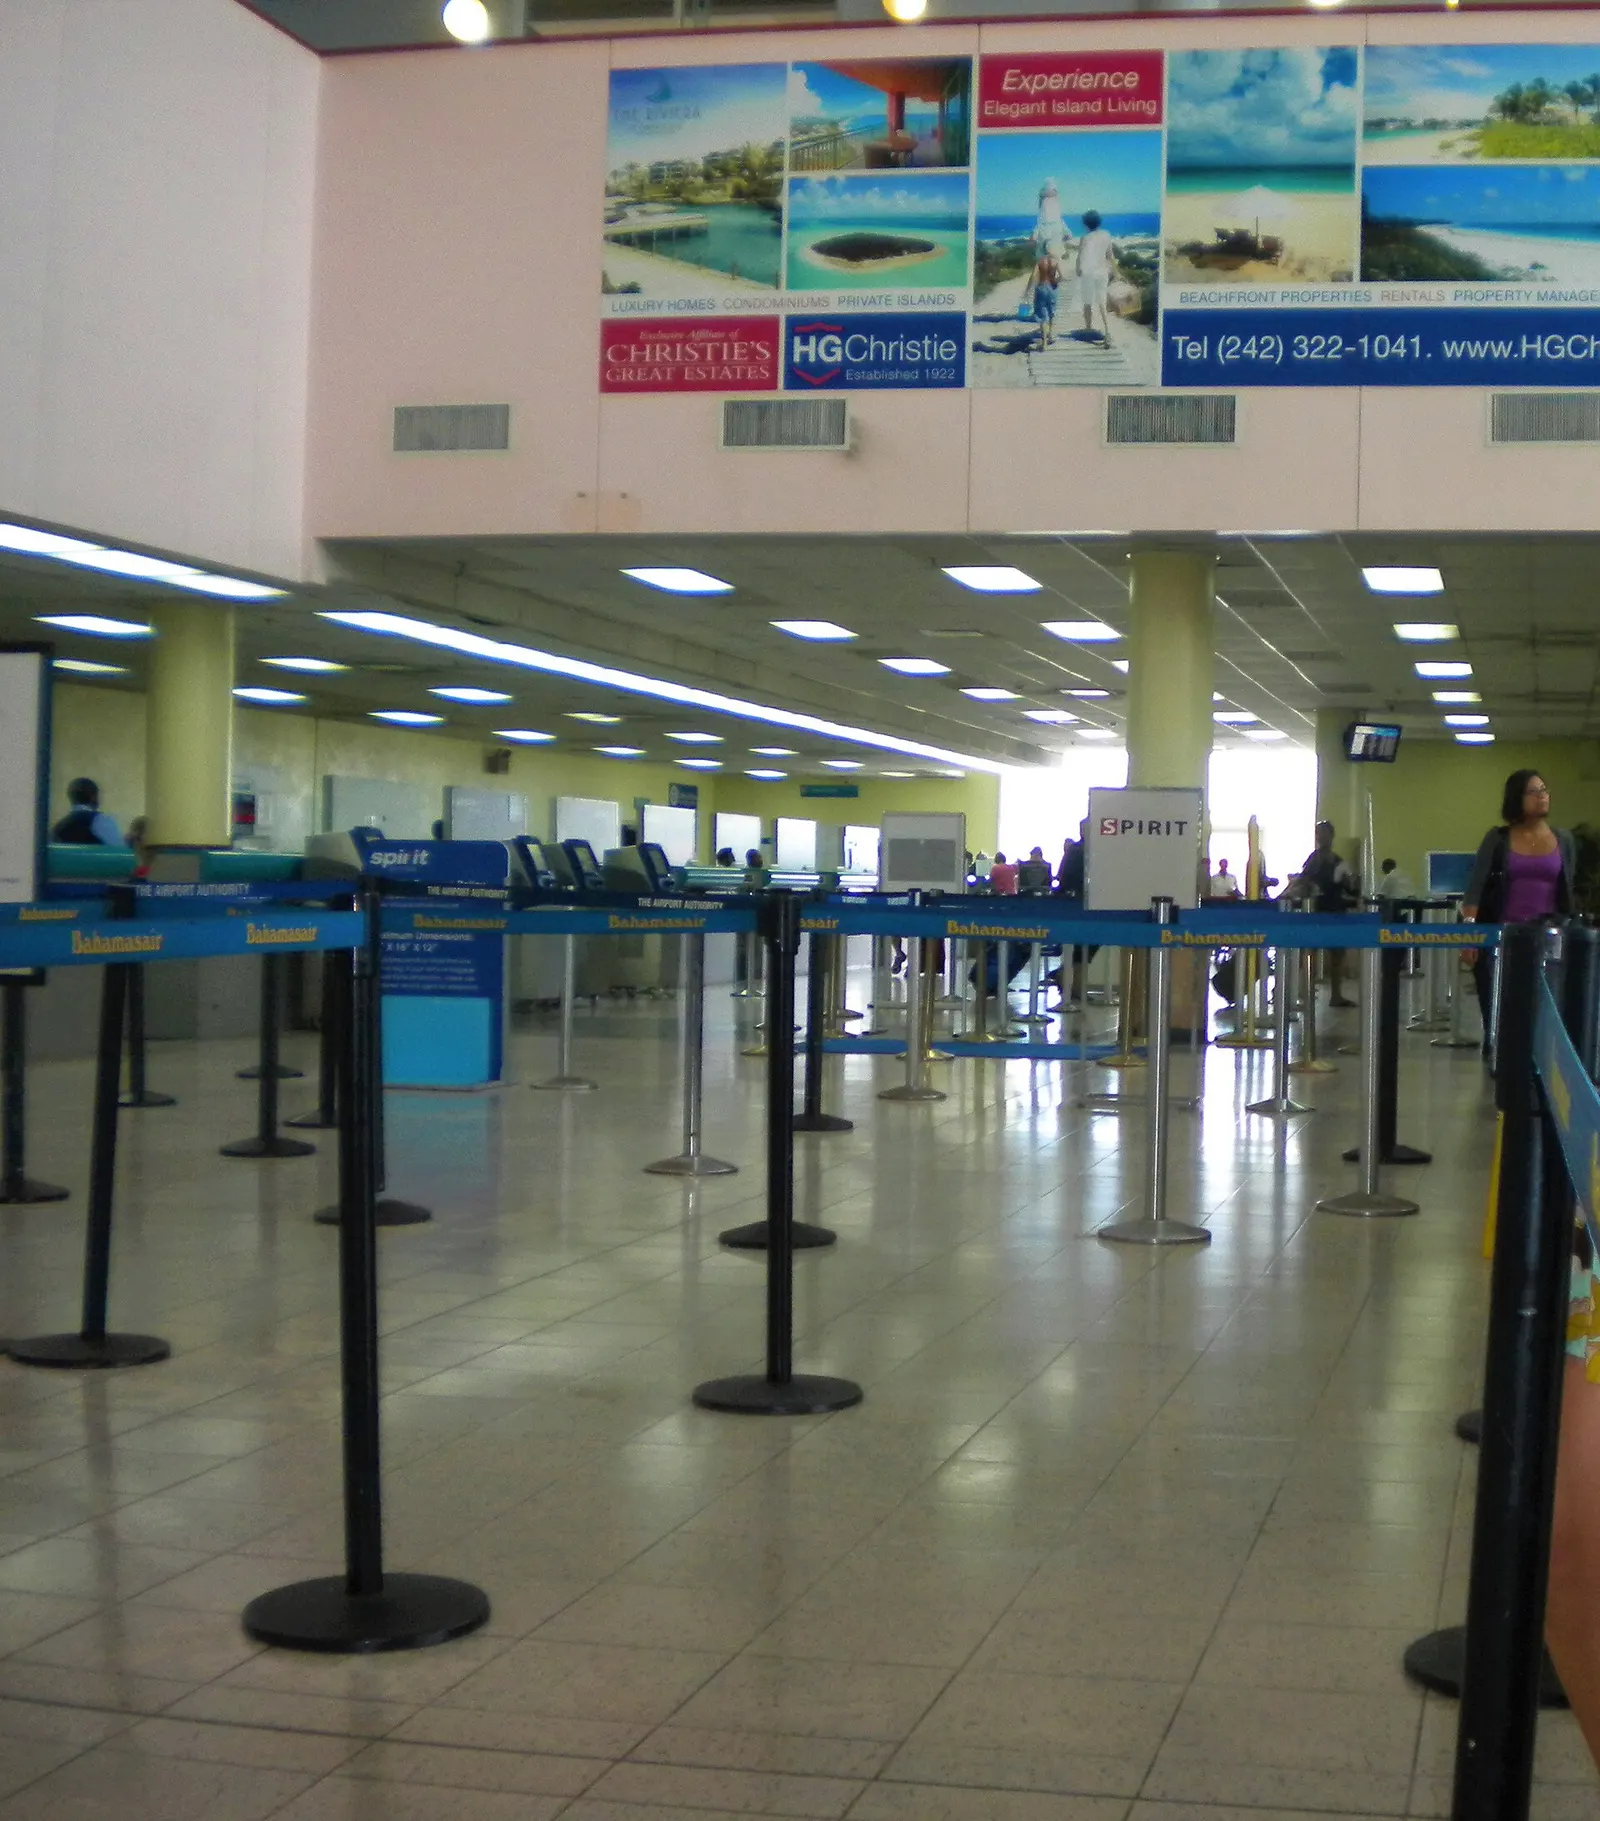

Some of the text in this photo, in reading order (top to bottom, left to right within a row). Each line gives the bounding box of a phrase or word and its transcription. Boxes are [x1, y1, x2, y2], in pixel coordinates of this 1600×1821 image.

[1002, 68, 1139, 94] Experience
[984, 97, 1156, 117] Elegant Island Living
[611, 292, 956, 312] LUXURY HOMES CONDOMINIUMS PRIVATE ISLANDS
[1179, 291, 1276, 303] BEACHFRONT
[1281, 290, 1372, 302] PROPERTIES
[1381, 290, 1446, 301] RENTALS
[1454, 289, 1533, 301] PROPERTY
[606, 341, 771, 363] CHRISTIE'S
[1171, 335, 1208, 360] Tel
[1217, 334, 1284, 365] (242)
[606, 364, 770, 382] GREAT ESTATES
[845, 367, 955, 381] Established 1922
[1100, 818, 1188, 836] SPIRIT
[369, 849, 430, 868] spirit
[608, 914, 706, 929] Bahamasair
[800, 916, 839, 929] asair
[947, 919, 1050, 939] Bahamasair
[1379, 928, 1488, 944] Bahamasair
